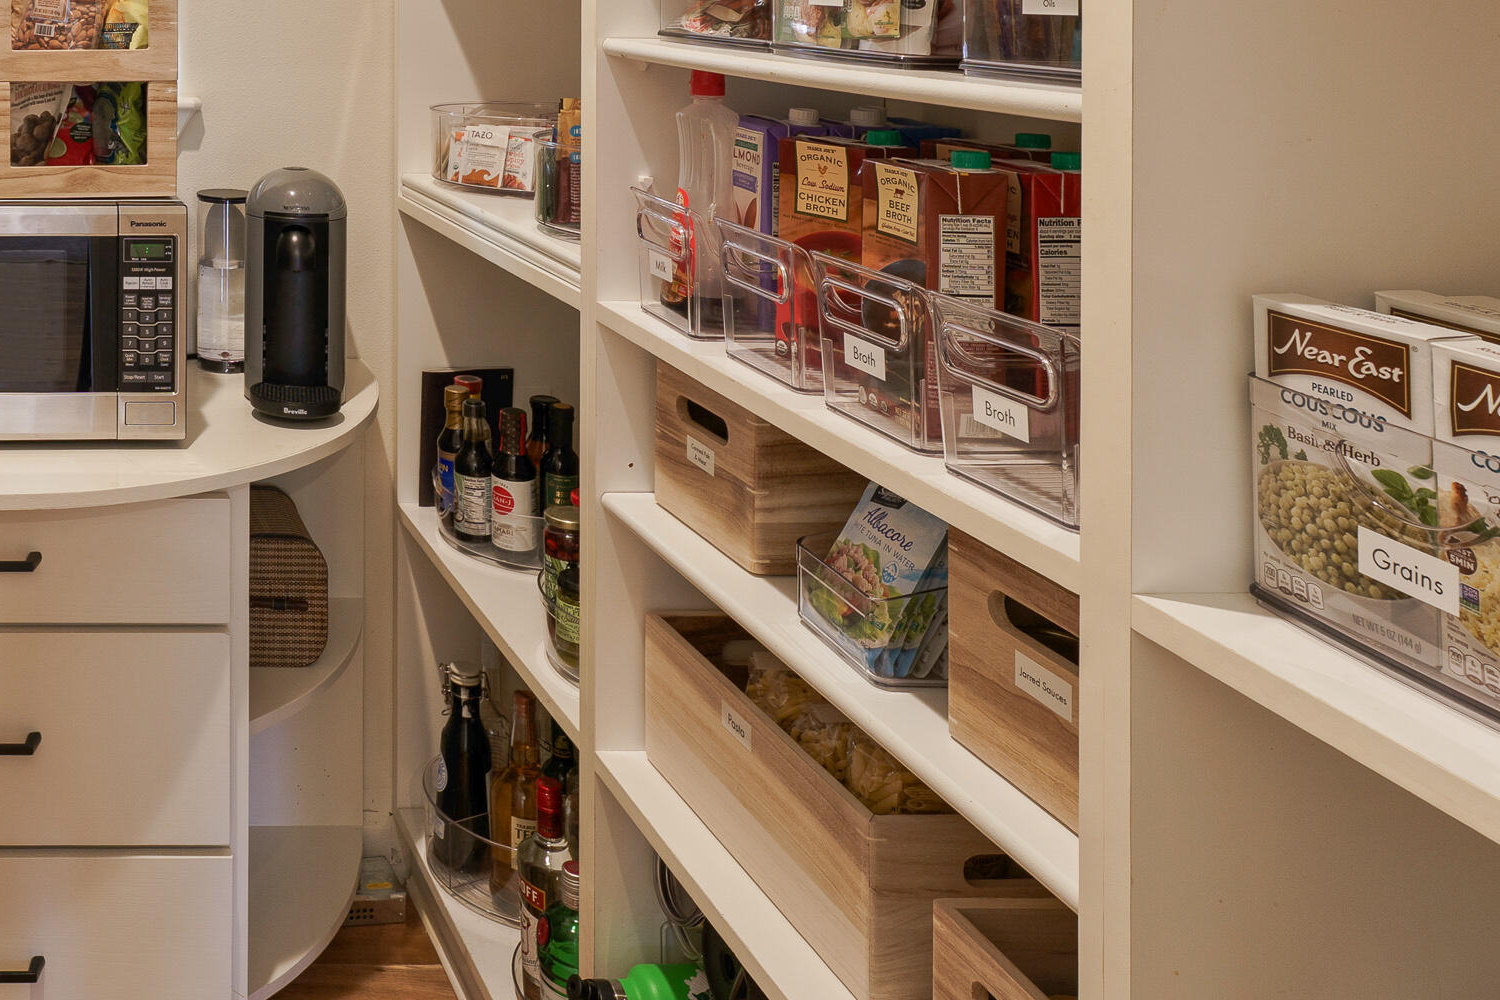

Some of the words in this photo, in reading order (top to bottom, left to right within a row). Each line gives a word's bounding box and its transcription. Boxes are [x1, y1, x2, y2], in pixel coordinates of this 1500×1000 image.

[1043, 0, 1055, 8] Oils
[800, 154, 843, 168] ORGANIC
[801, 177, 817, 187] Low
[819, 180, 845, 193] Sodium
[880, 177, 915, 194] ORGANIC
[799, 192, 846, 208] CHICKEN
[806, 203, 839, 216] BROTH
[889, 200, 911, 213] BEEF
[130, 220, 167, 228] Panasonic
[885, 210, 912, 225] BROTH
[1039, 218, 1074, 226] Nutrition
[853, 346, 876, 367] Broth
[1274, 328, 1346, 367] Near
[1347, 346, 1403, 383] East
[1311, 382, 1353, 402] PEARLED
[985, 401, 1015, 427] Broth
[1281, 389, 1387, 433] COUSCOUS
[1321, 420, 1338, 432] MIX
[1323, 439, 1336, 453] &
[1342, 444, 1381, 467] Herb
[863, 507, 913, 552] Albacore
[866, 530, 882, 547] TUNA
[883, 543, 893, 553] IN
[893, 550, 915, 571] WATER
[1372, 548, 1444, 596] Grains
[1352, 613, 1365, 626] NET
[1366, 619, 1379, 632] WT
[1386, 629, 1396, 642] OZ
[1019, 666, 1041, 687] Jarred
[1041, 681, 1068, 706] Sauces
[727, 712, 745, 738] Pasta
